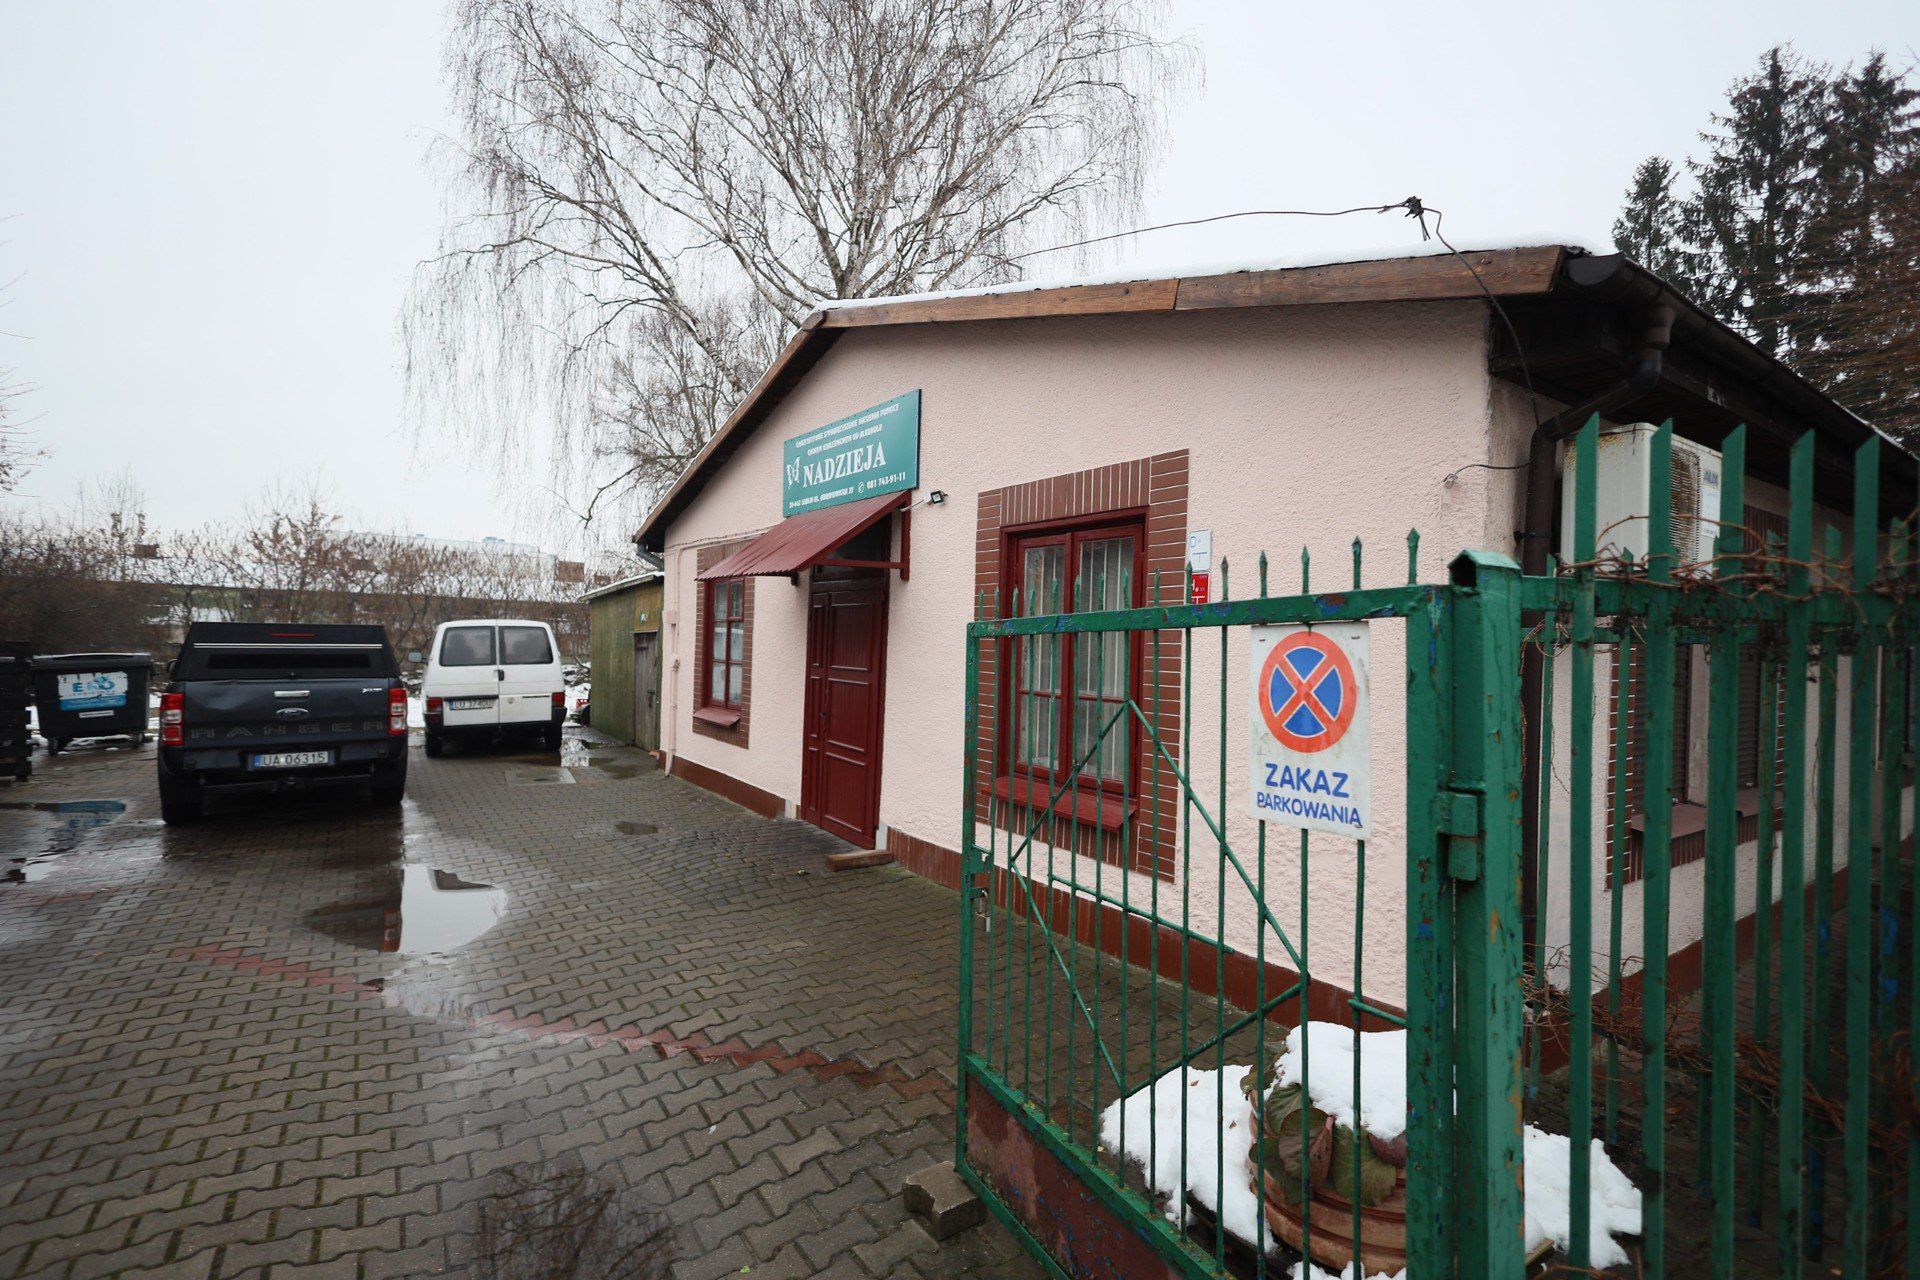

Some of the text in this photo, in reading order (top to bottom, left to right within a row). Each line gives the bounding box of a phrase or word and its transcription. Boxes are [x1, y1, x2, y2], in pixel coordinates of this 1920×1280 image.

[802, 441, 886, 488] NADZIEJA
[191, 721, 384, 739] RANGER
[263, 753, 326, 767] UA 06315
[1265, 762, 1350, 799] ZAKAZ
[1257, 791, 1363, 828] PARKOWANIA
